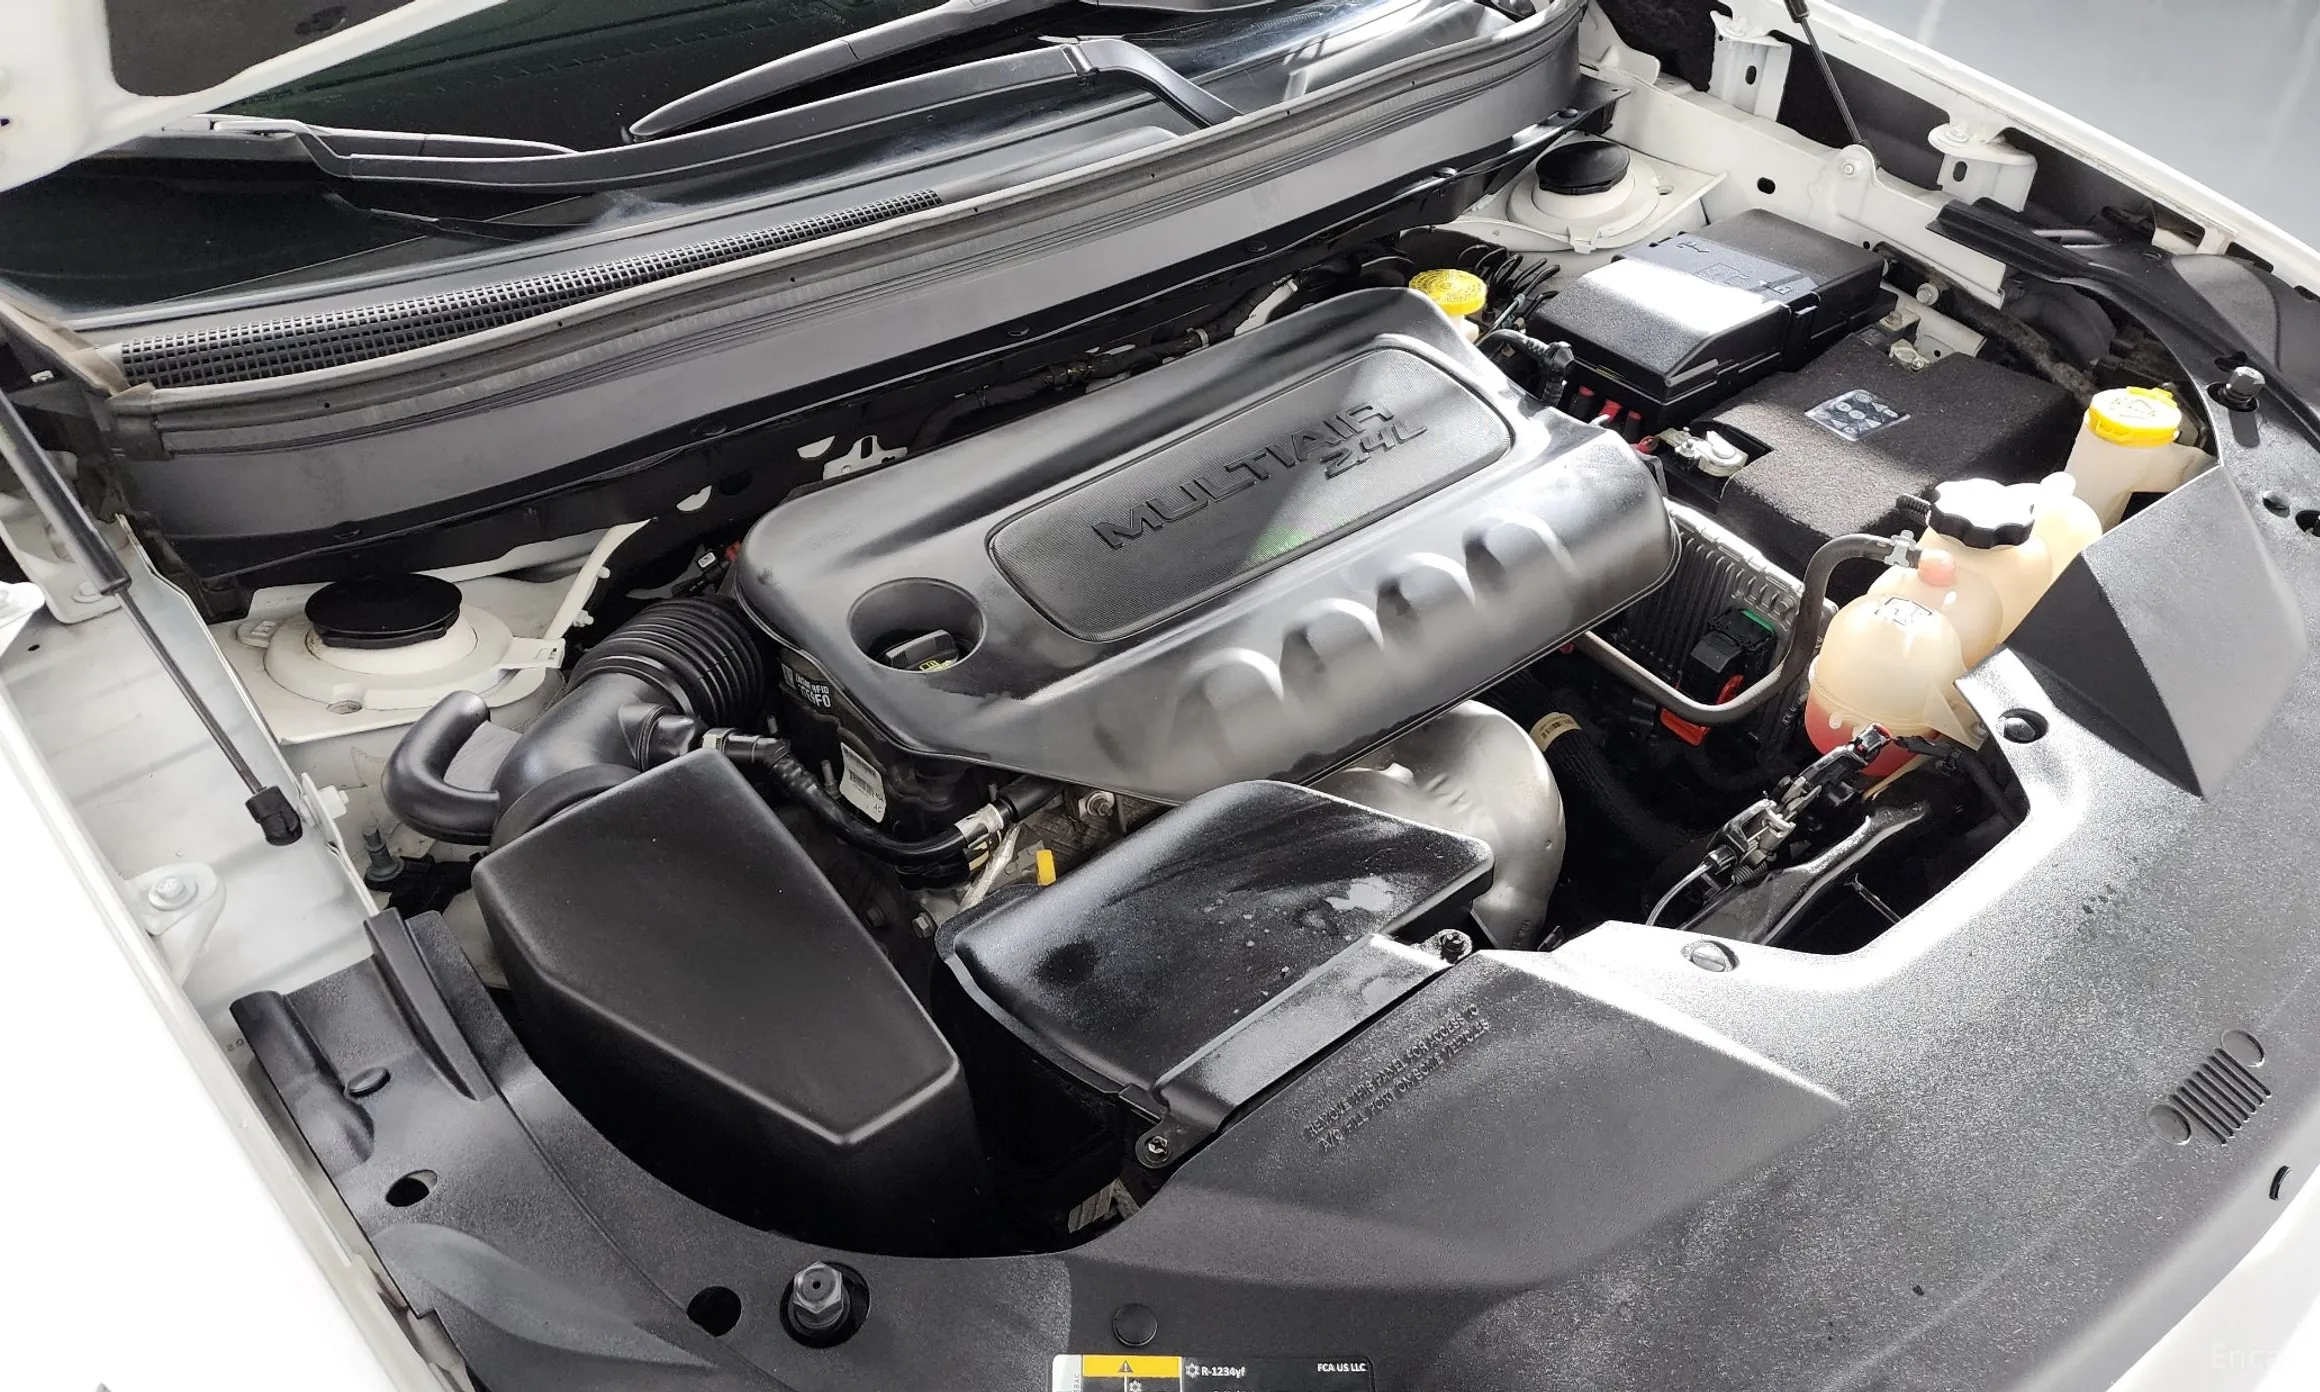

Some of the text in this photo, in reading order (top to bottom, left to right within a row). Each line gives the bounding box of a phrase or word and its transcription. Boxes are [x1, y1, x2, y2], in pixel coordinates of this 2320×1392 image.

[1092, 402, 1395, 550] MULTIAIR
[1372, 1054, 1409, 1087] PANEL
[1425, 1011, 1468, 1048] ACCESS
[1201, 1362, 1367, 1379] R-1234yf FCA US LLC
